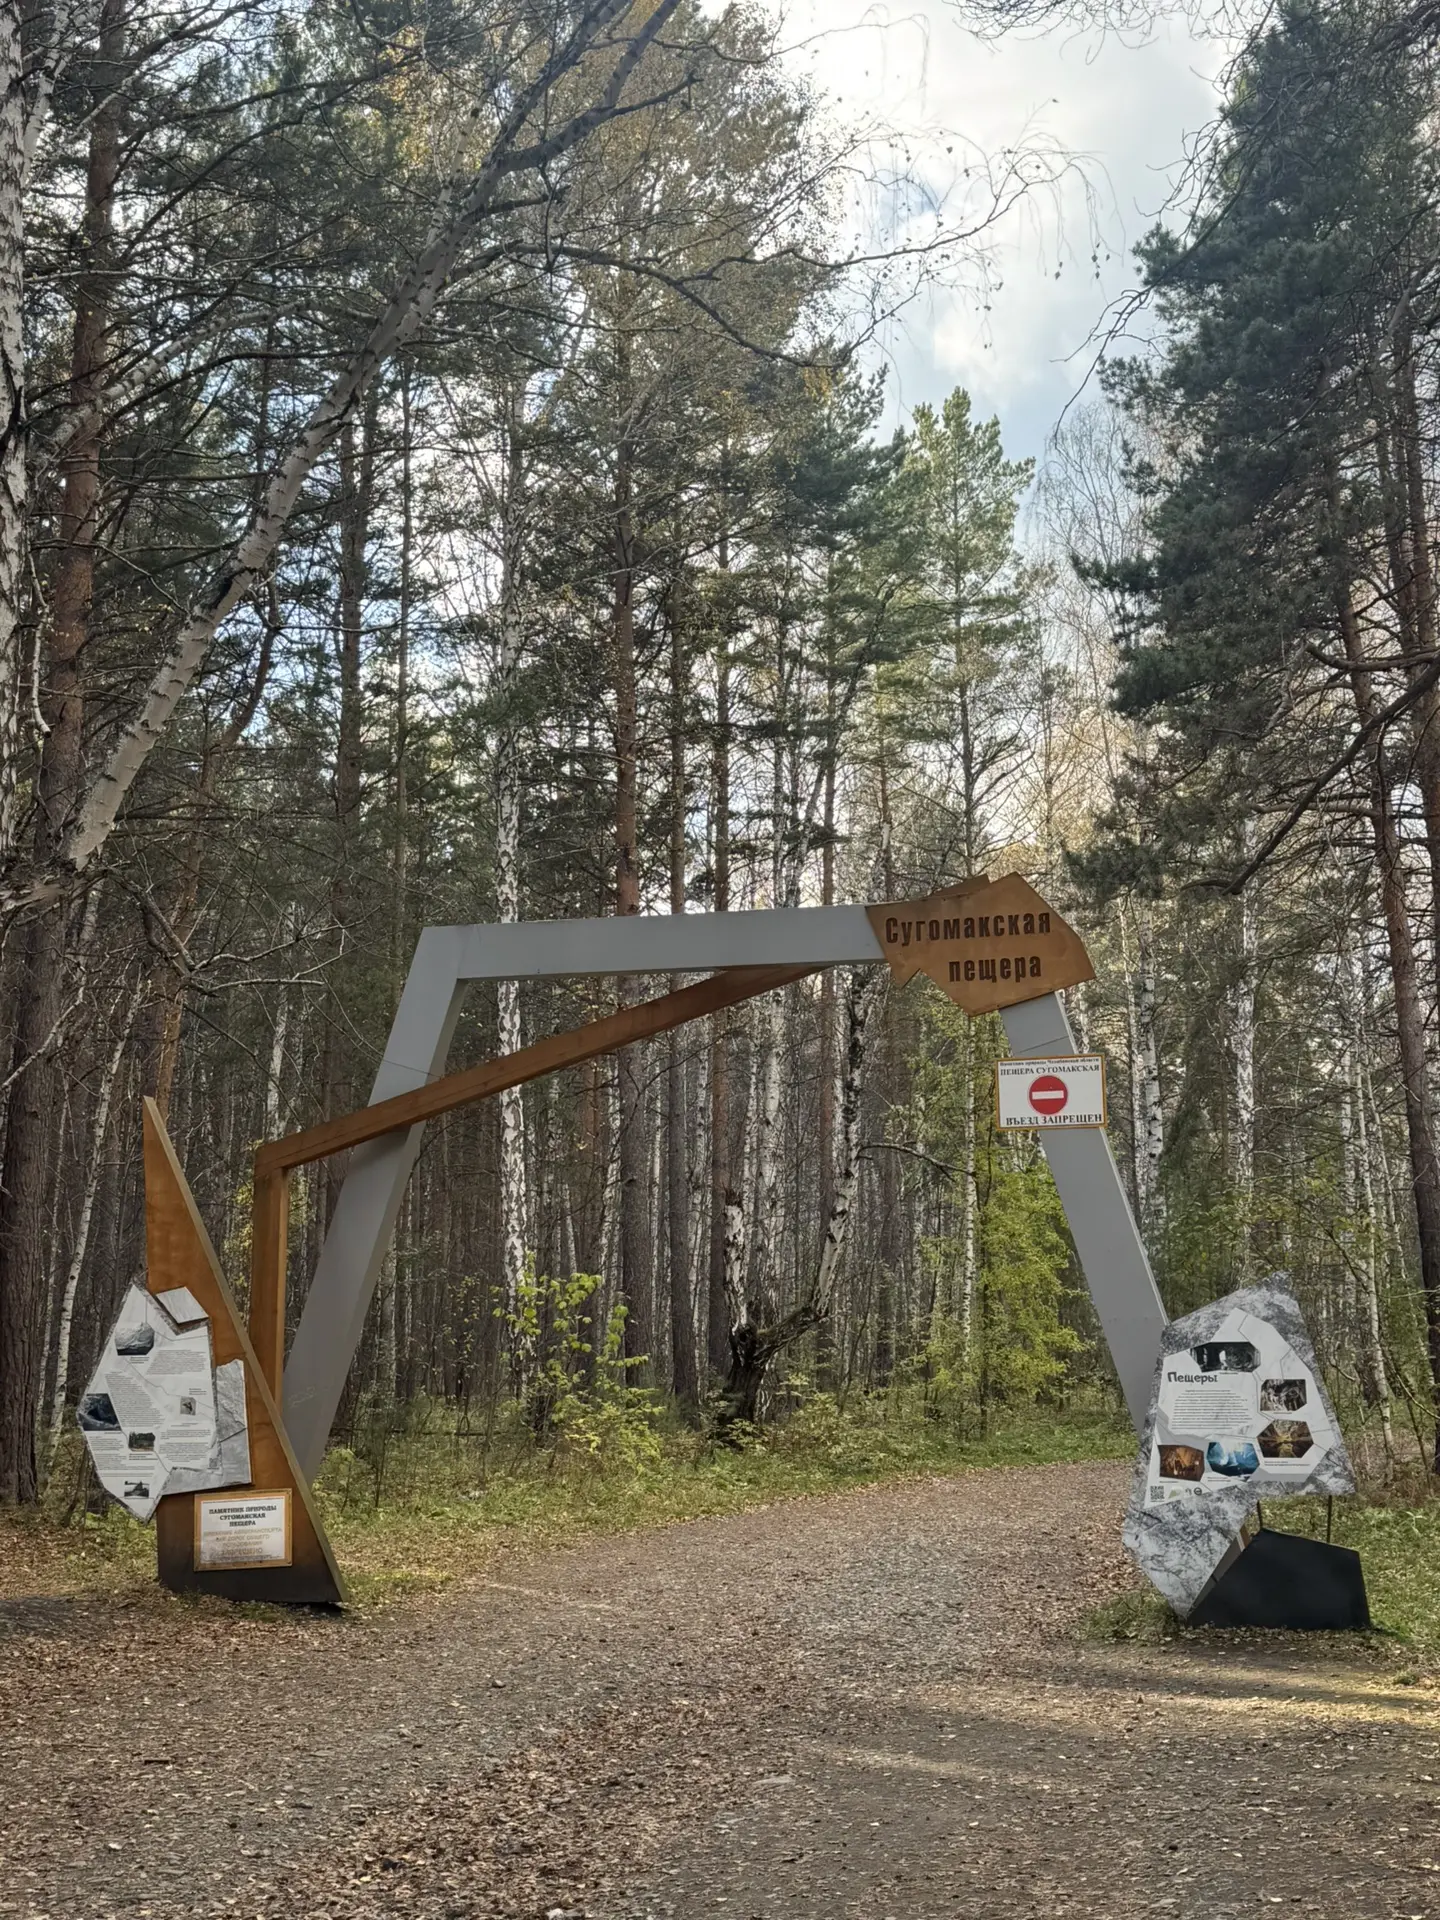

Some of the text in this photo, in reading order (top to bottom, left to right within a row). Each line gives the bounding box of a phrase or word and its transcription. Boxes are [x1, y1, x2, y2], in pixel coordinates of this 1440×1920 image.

[885, 912, 1051, 947] Сугомакская
[949, 956, 1042, 983] пещера
[1000, 1064, 1100, 1076] ПЕЩЕРА СУГОМАКСКАЯ
[1006, 1113, 1102, 1126] ВЪЕЗД ЗАПРЕЩЕН
[1167, 1371, 1218, 1385] Пещеры
[219, 1513, 266, 1521] СУГОМАКСКАЯ
